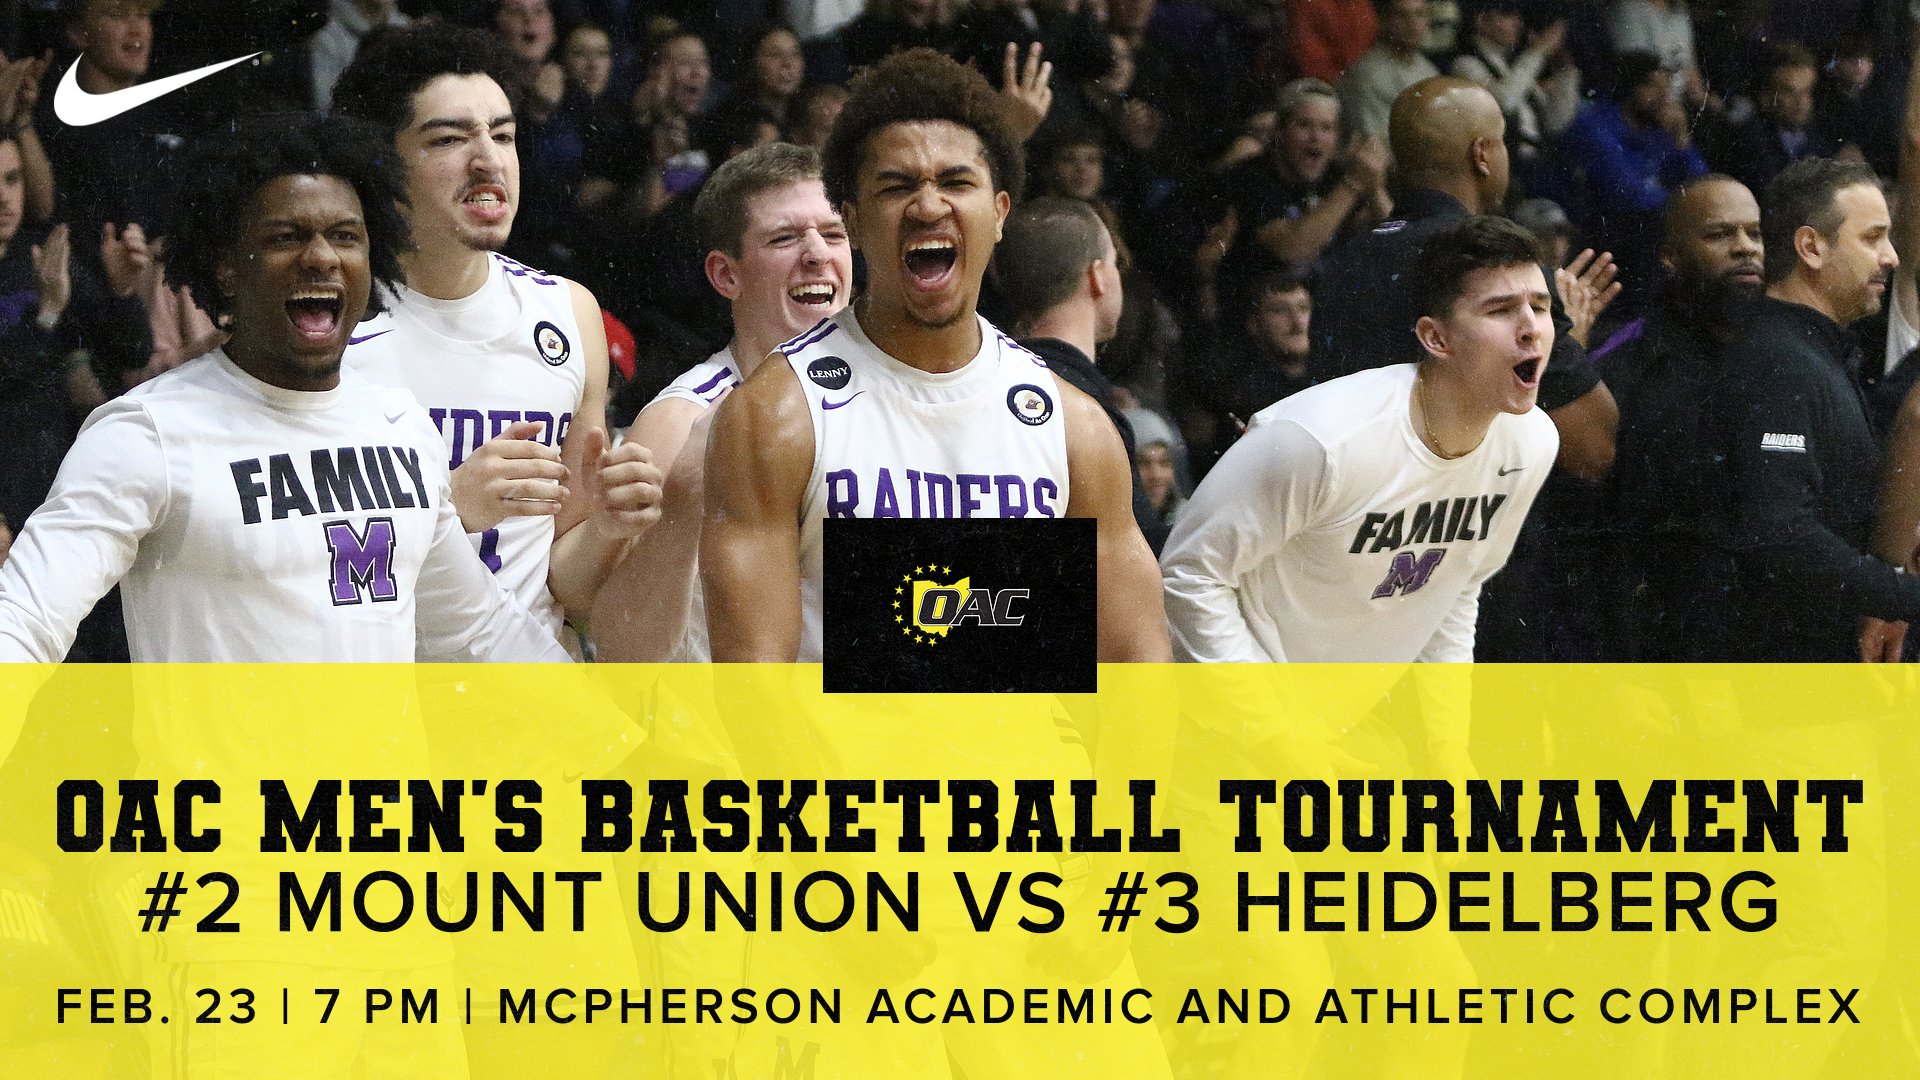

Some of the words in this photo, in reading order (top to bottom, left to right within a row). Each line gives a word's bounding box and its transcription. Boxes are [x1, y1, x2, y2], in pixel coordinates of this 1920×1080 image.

[808, 366, 849, 378] LENNY
[1761, 433, 1807, 448] RAIDERS
[229, 446, 430, 525] FAMILY
[826, 467, 1058, 518] RAIDERS
[1348, 493, 1508, 554] FAMILY
[322, 516, 398, 606] M
[1371, 547, 1448, 600] M
